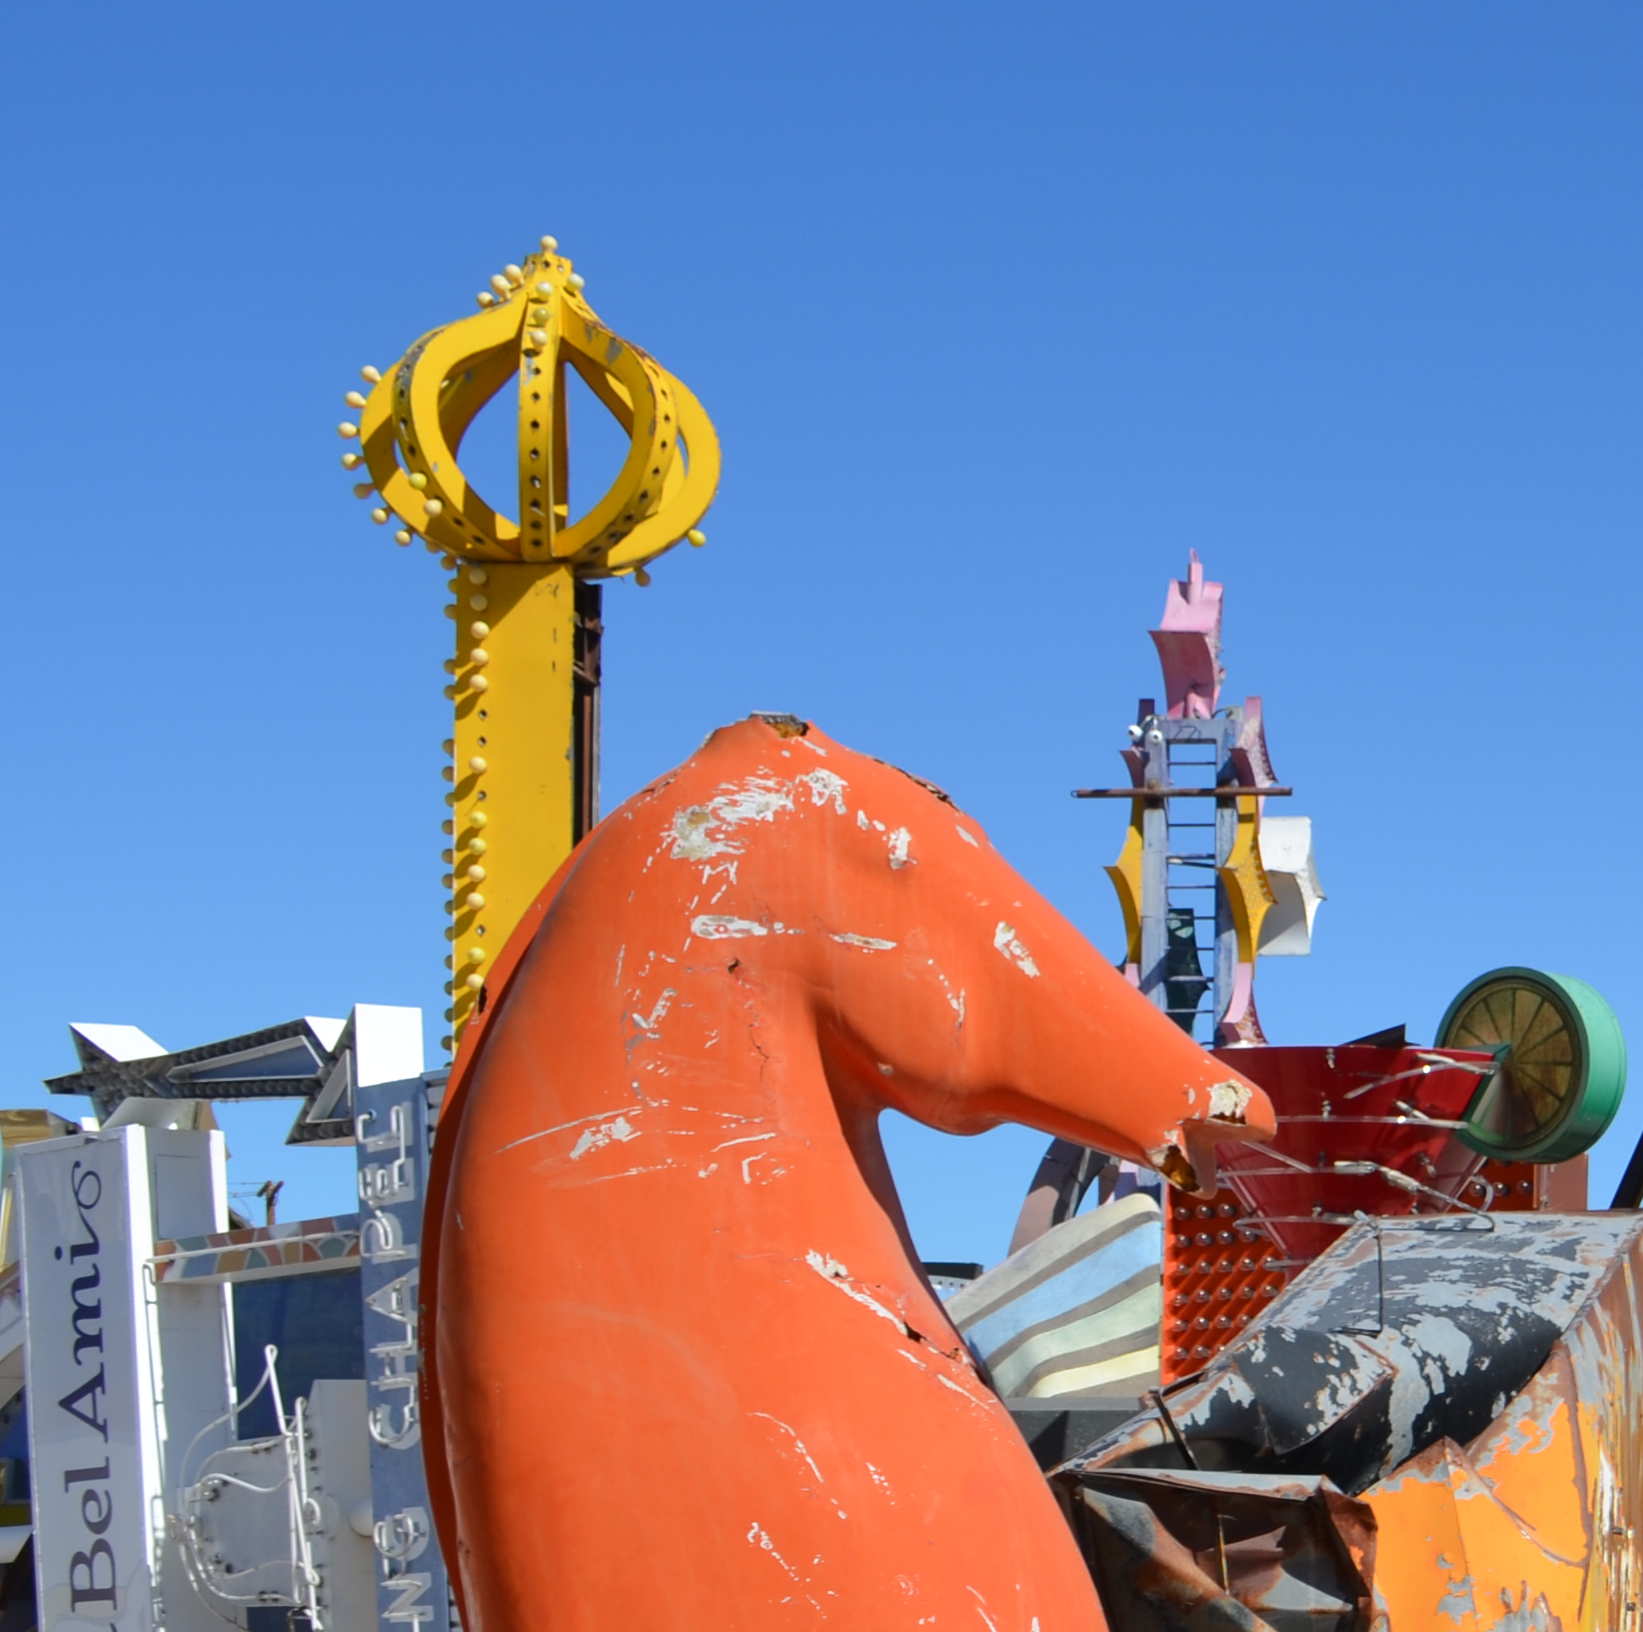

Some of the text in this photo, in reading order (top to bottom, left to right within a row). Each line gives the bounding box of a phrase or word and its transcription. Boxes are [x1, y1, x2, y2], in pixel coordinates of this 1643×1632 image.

[54, 1160, 109, 1443] Ami
[355, 1105, 421, 1450] CHAPEL
[63, 1456, 118, 1613] Bel
